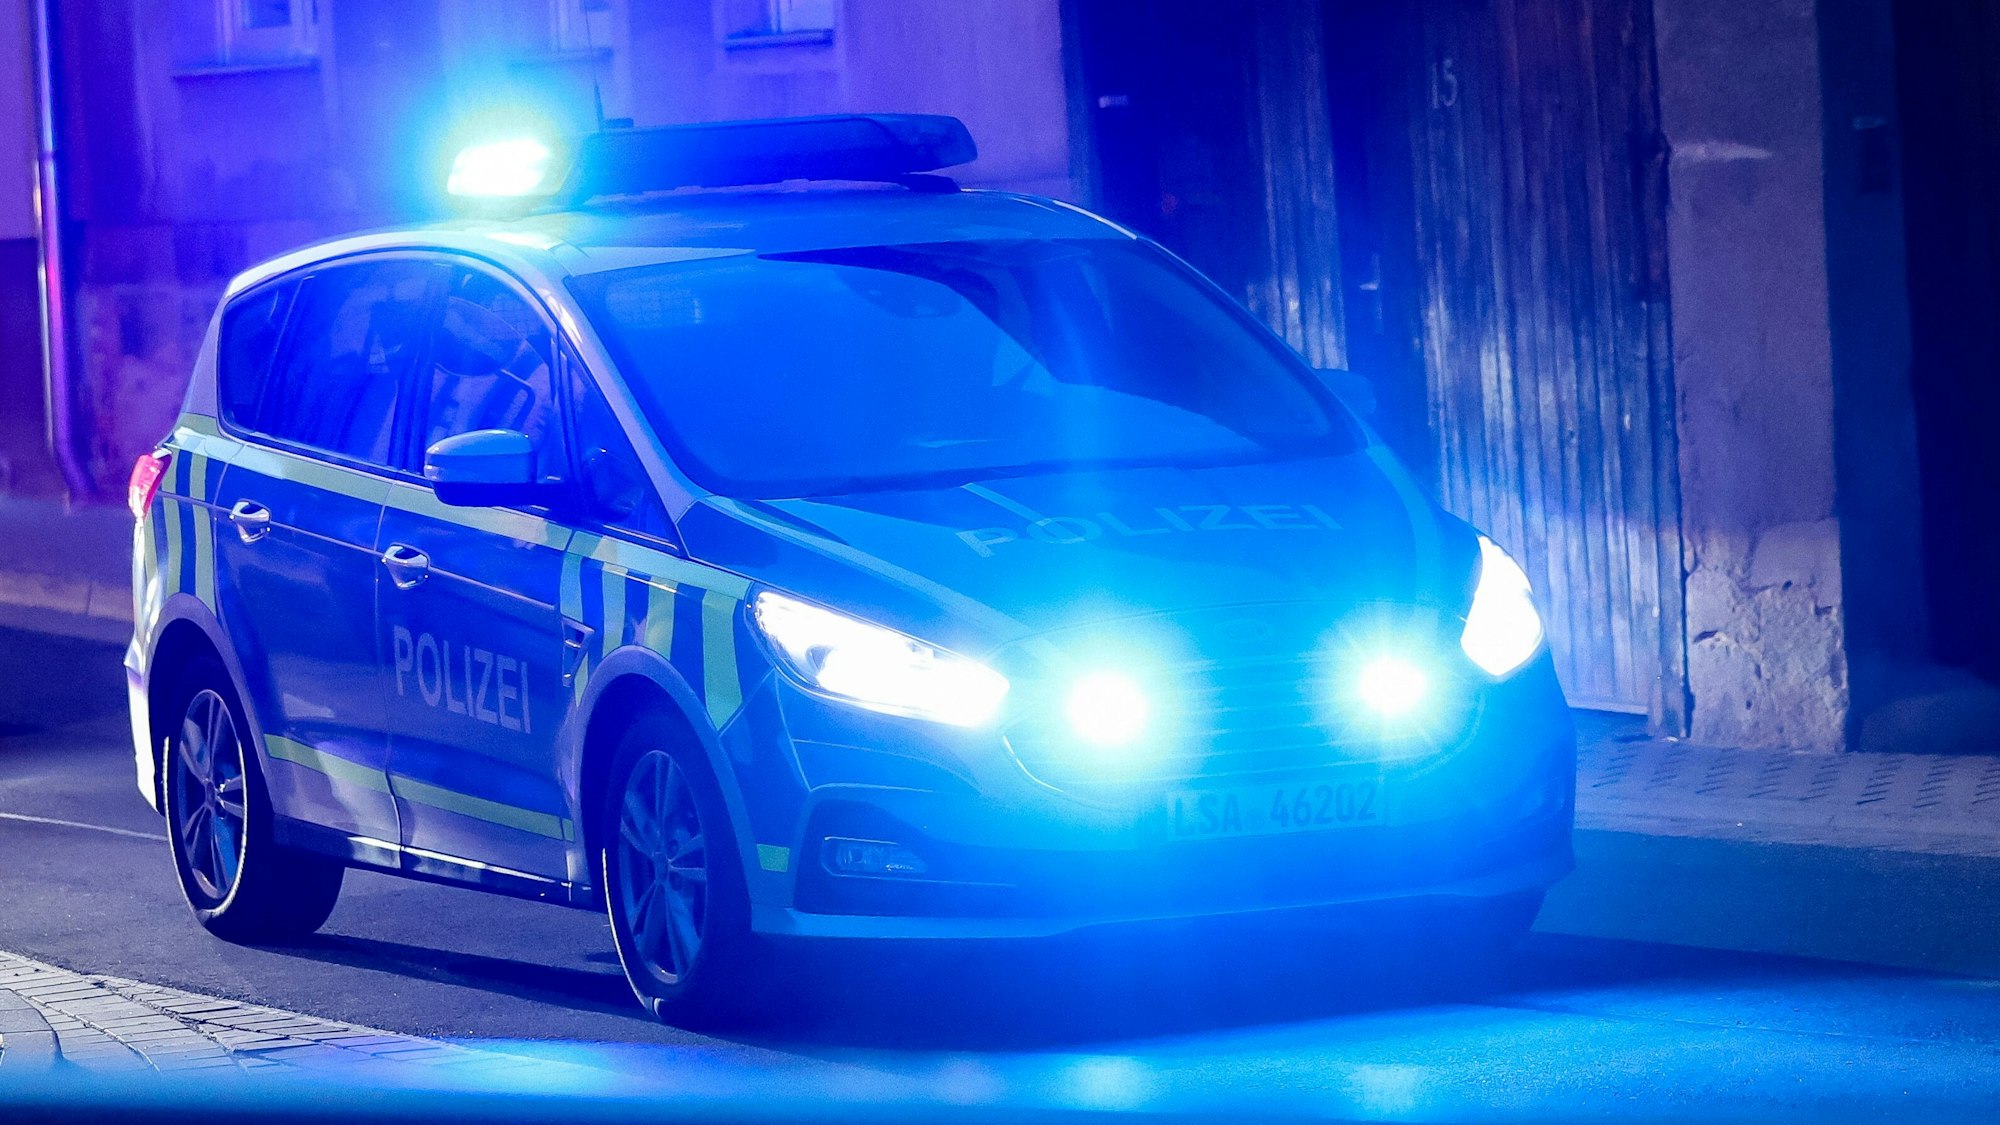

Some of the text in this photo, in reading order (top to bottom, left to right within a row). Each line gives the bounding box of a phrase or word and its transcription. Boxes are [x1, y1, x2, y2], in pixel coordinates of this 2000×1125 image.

[1431, 59, 1458, 109] 15
[956, 504, 1344, 558] POLIZEI
[393, 624, 532, 734] POLIZEI
[1174, 781, 1378, 838] LSA 46202
